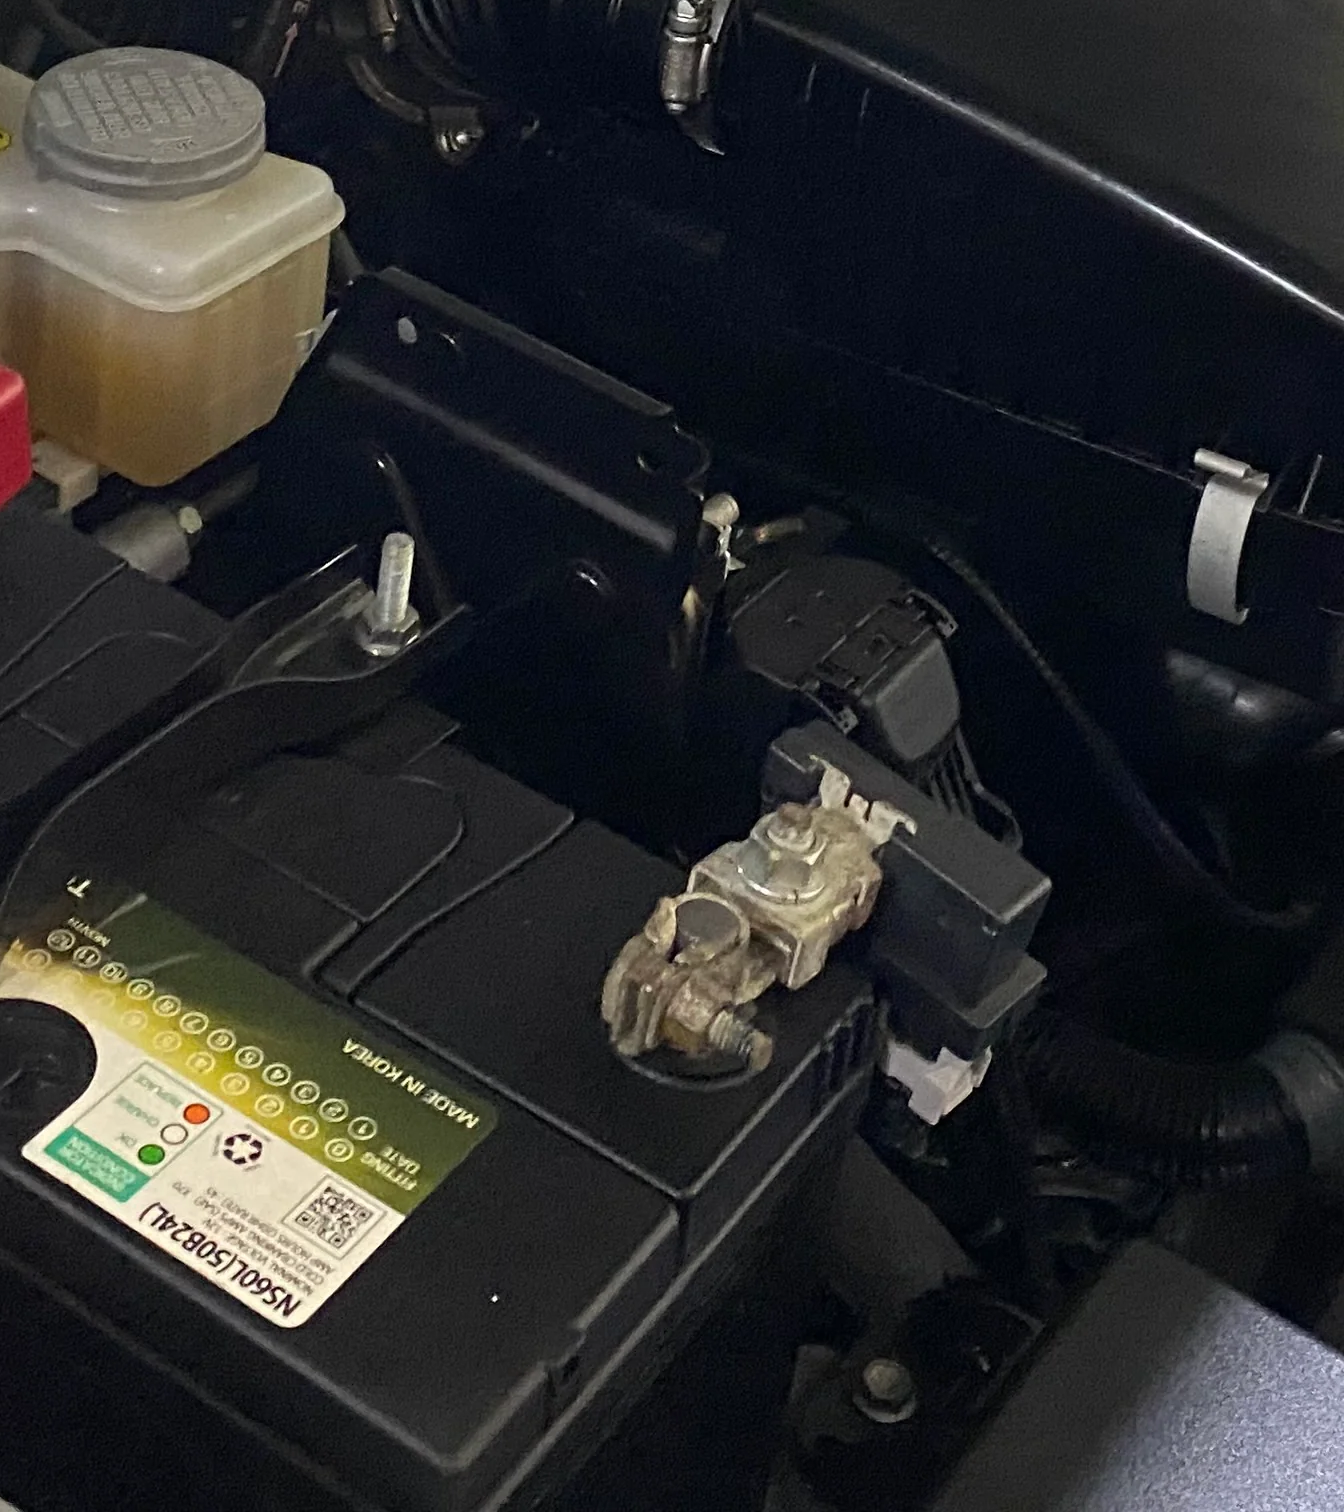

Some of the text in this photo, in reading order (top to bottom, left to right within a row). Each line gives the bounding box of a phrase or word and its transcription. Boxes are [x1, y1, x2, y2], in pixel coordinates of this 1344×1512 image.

[341, 1038, 479, 1128] MADE IN KOREA
[359, 1151, 418, 1191] FITTING
[380, 1145, 420, 1174] DATE
[140, 1203, 299, 1316] NS60L(50B24L)
